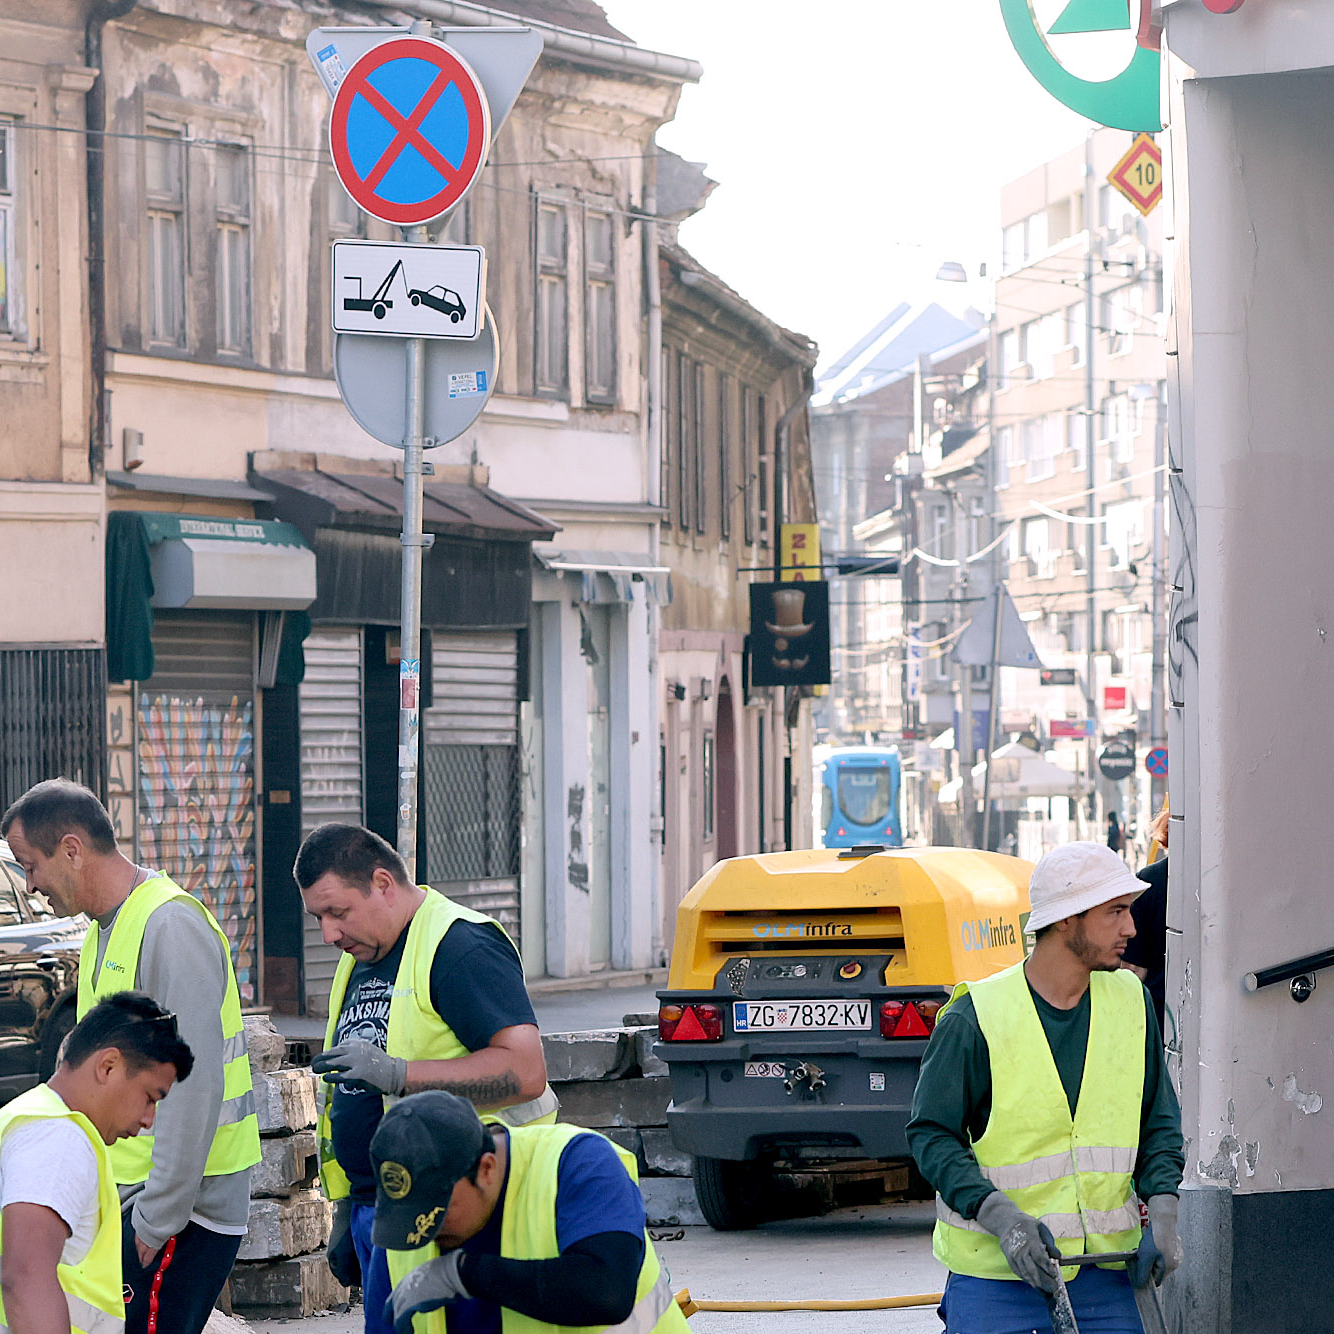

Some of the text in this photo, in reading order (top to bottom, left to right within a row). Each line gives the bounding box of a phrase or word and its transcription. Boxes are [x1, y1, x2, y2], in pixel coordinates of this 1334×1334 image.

[1135, 163, 1155, 186] 10
[752, 921, 853, 938] OLMinfra
[960, 916, 1016, 952] OLMinfra
[735, 1019, 748, 1028] HR
[749, 1005, 775, 1027] ZG
